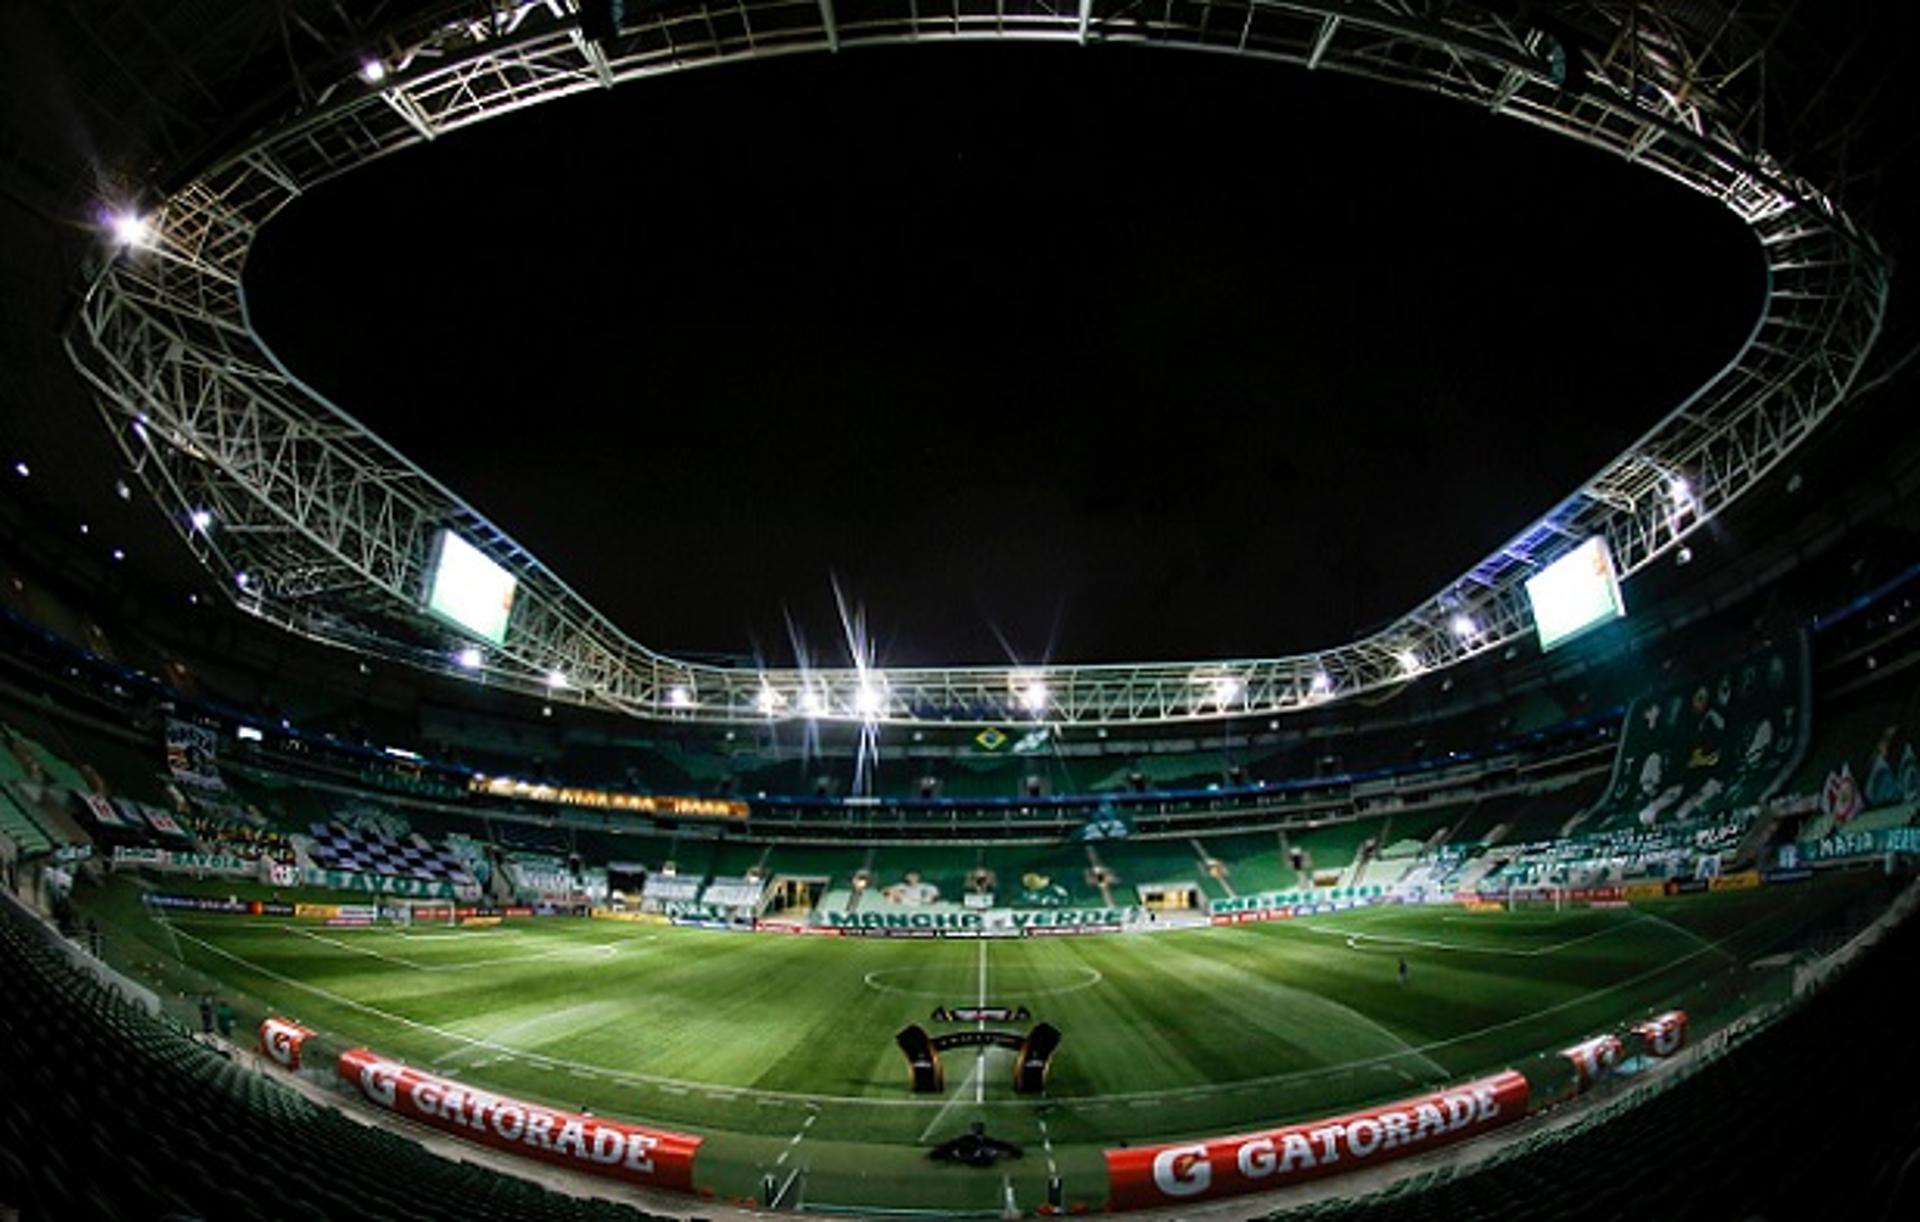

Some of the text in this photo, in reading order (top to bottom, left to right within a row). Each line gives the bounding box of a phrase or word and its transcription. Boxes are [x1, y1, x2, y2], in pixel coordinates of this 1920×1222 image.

[828, 910, 983, 929] MANCHA
[1011, 907, 1126, 928] VERDE
[266, 1025, 291, 1065] G
[361, 1061, 659, 1172] G GATORADE
[1153, 1086, 1501, 1196] G GATORADE
